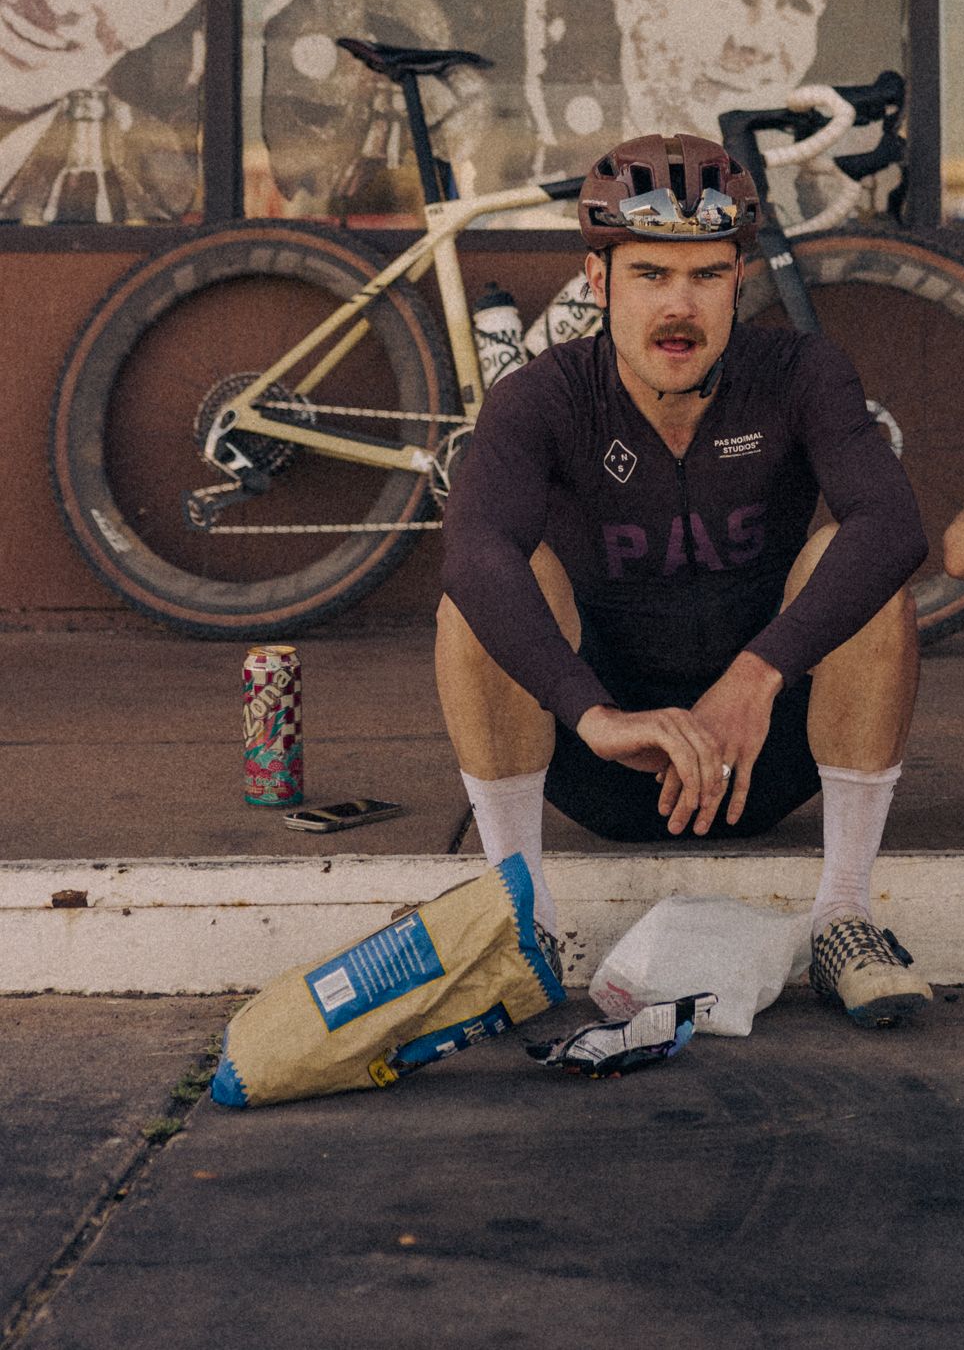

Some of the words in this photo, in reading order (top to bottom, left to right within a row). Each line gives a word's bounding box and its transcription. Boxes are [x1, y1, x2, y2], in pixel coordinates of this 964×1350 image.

[714, 438, 730, 447] PAS
[731, 432, 764, 445] NORMAL
[603, 502, 767, 578] PAS
